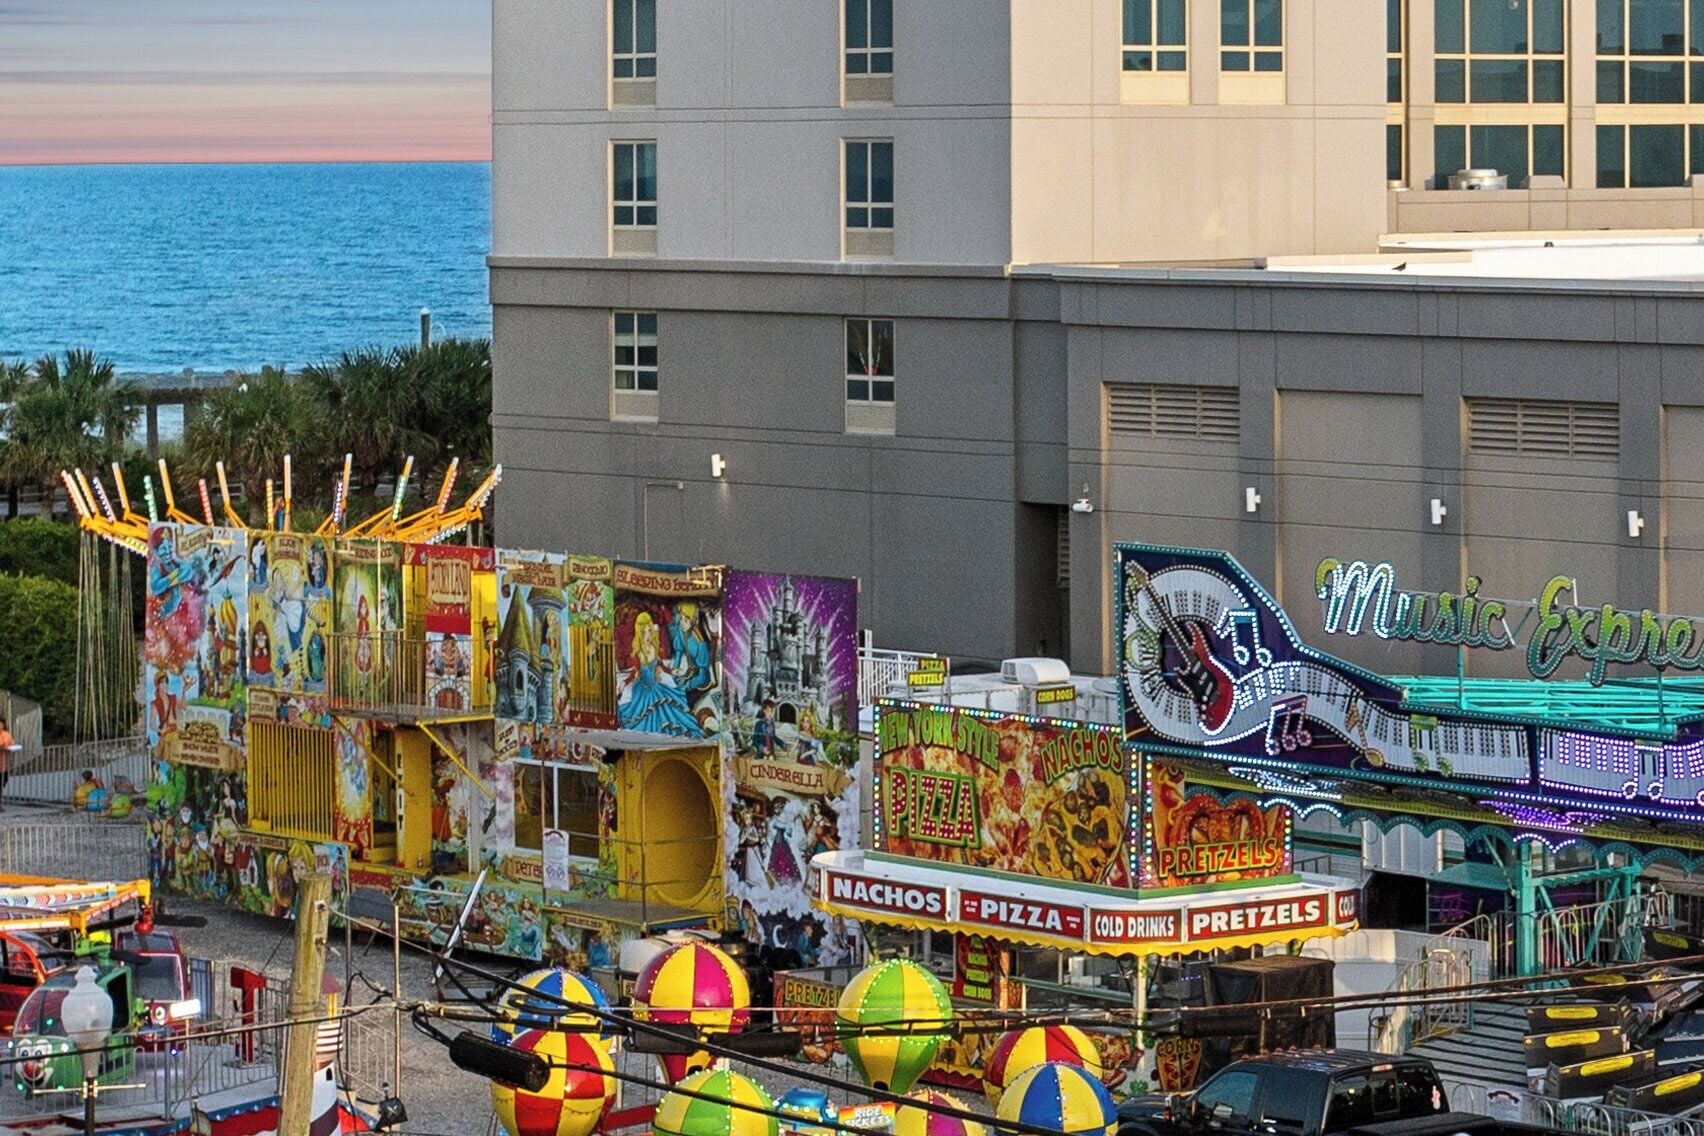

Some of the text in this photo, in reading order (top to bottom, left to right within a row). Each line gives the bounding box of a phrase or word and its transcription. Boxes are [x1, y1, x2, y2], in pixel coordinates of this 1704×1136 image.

[616, 569, 672, 591] SLEEPING
[1315, 557, 1512, 650] Music
[908, 672, 944, 685] PRETZELS
[920, 659, 946, 671] PIZZA
[1036, 687, 1075, 703] CORN DOGS
[878, 708, 1000, 772] NEW YORK STYLE
[1041, 729, 1124, 786] NACHOS
[750, 762, 824, 788] CINDERELLA
[889, 770, 979, 848] PIZZA
[1159, 837, 1279, 879] PRETZELS
[832, 878, 942, 914] NACHOS
[980, 898, 1063, 931] PIZZA
[1095, 915, 1123, 937] COLD
[1126, 915, 1175, 938] DRINKS
[1192, 899, 1321, 935] PRETZELS
[845, 1106, 892, 1129] RIDE TICKETS
